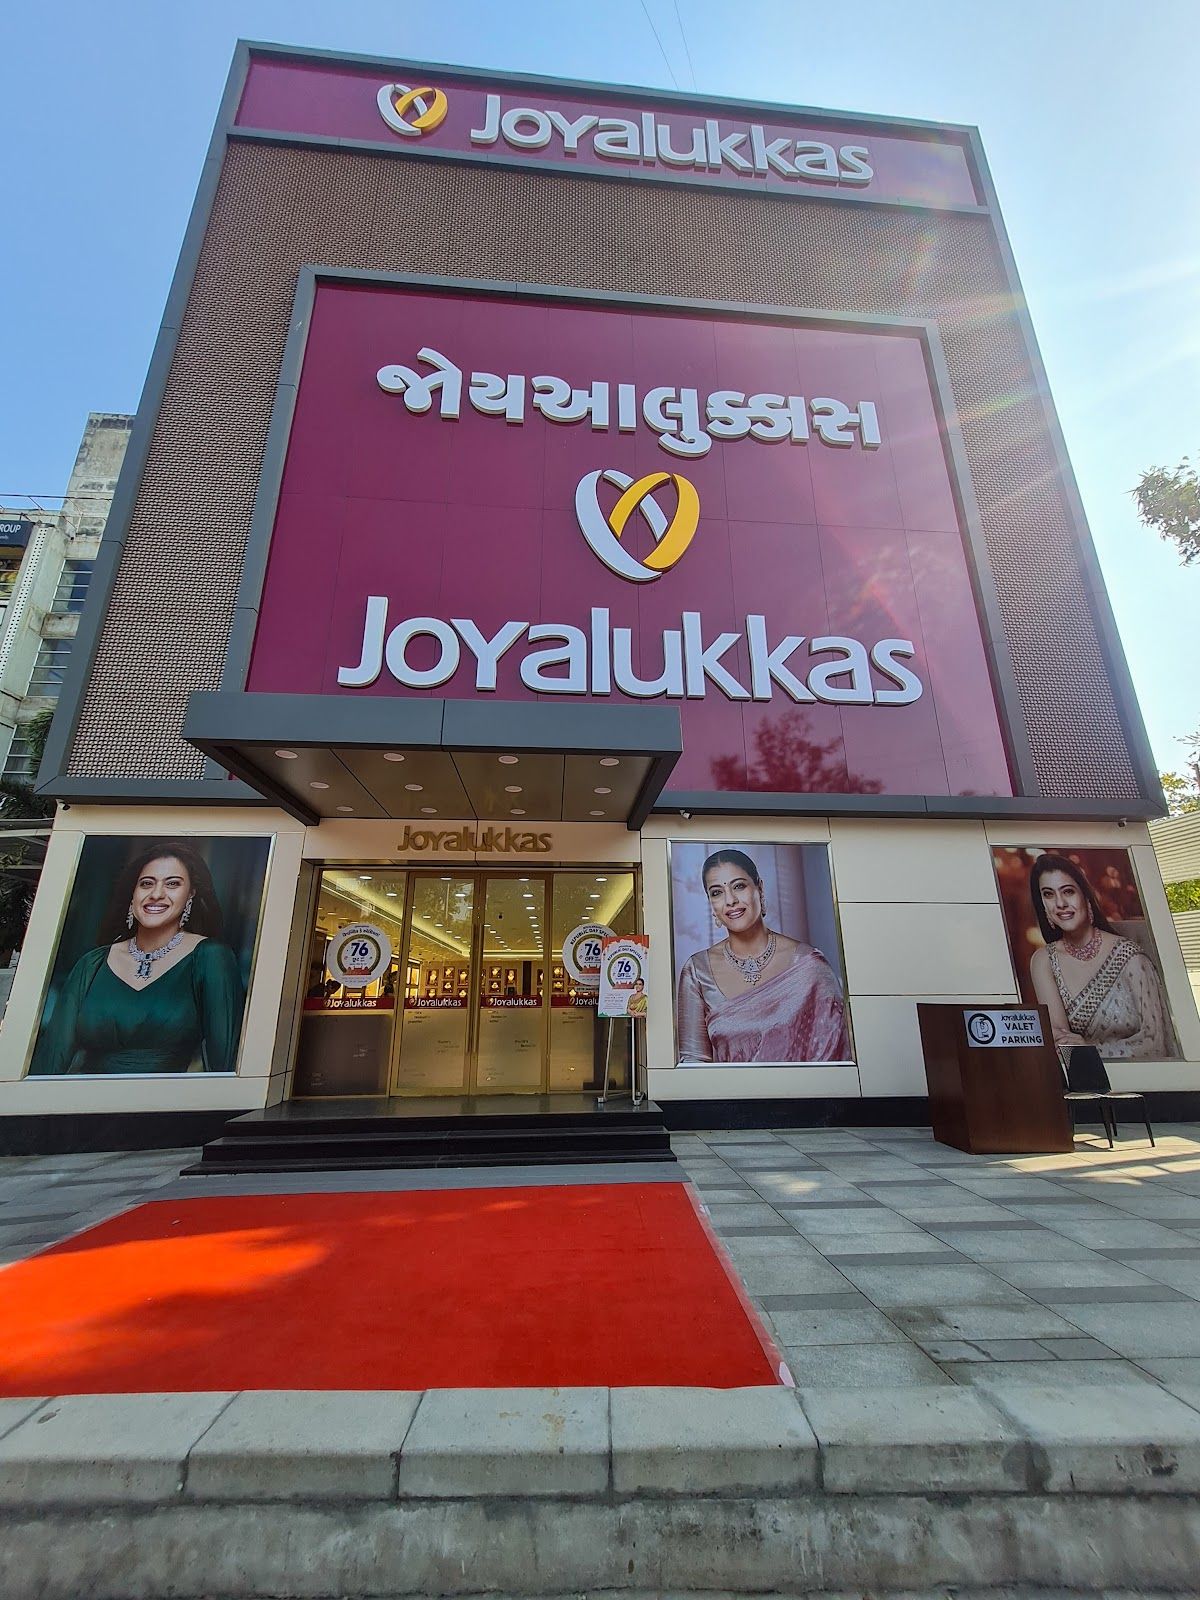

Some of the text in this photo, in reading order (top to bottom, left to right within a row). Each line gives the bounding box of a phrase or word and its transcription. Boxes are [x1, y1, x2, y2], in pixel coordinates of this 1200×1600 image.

[470, 94, 875, 184] Joyalukkas
[337, 595, 924, 705] Joyalukkas
[351, 942, 369, 957] 76
[585, 943, 600, 956] 76
[617, 961, 631, 973] 76
[1005, 1022, 1034, 1030] VALET
[1001, 1035, 1042, 1043] PARKING
